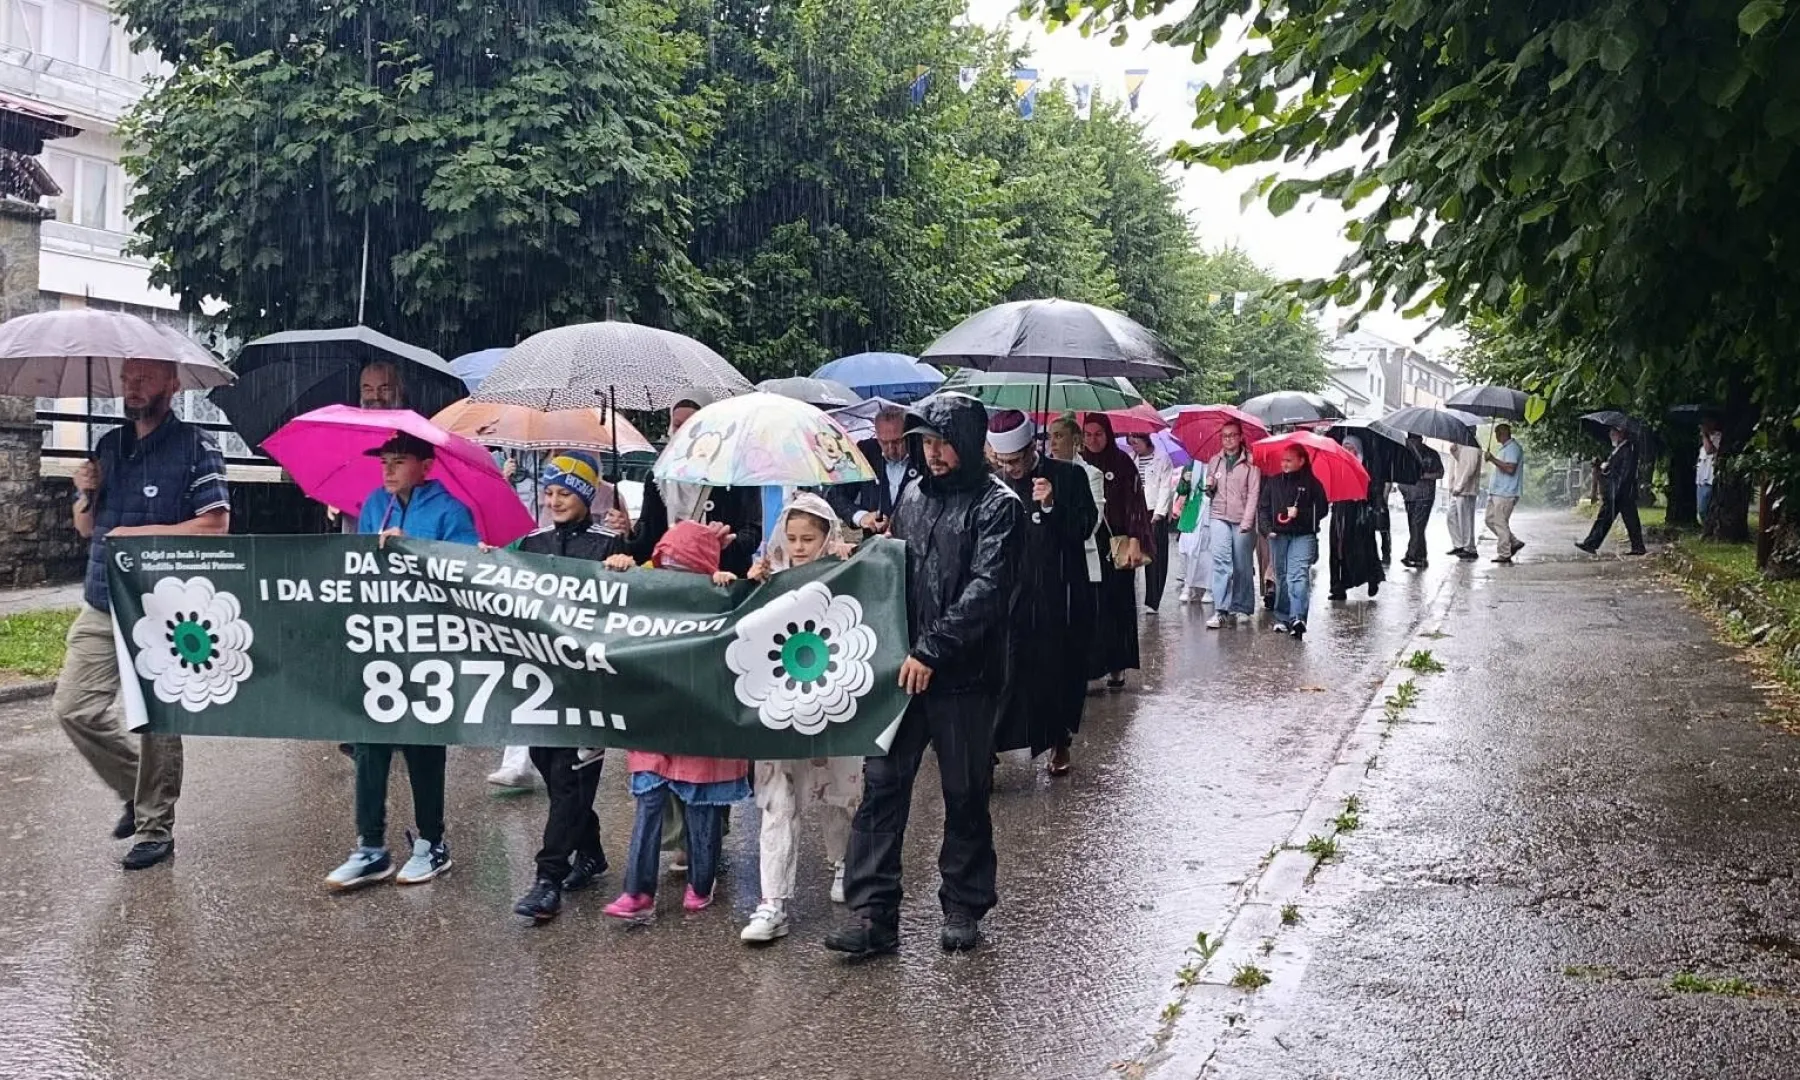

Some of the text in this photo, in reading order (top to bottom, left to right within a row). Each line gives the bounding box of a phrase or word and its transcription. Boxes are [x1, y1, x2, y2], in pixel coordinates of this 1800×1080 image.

[260, 579, 728, 637] I DA SE NIKAD NIKOM NE PONOVI
[345, 552, 629, 607] DA SE NE ZABORAVI
[345, 613, 618, 675] SREBRENICA
[362, 659, 627, 730] 8372...
